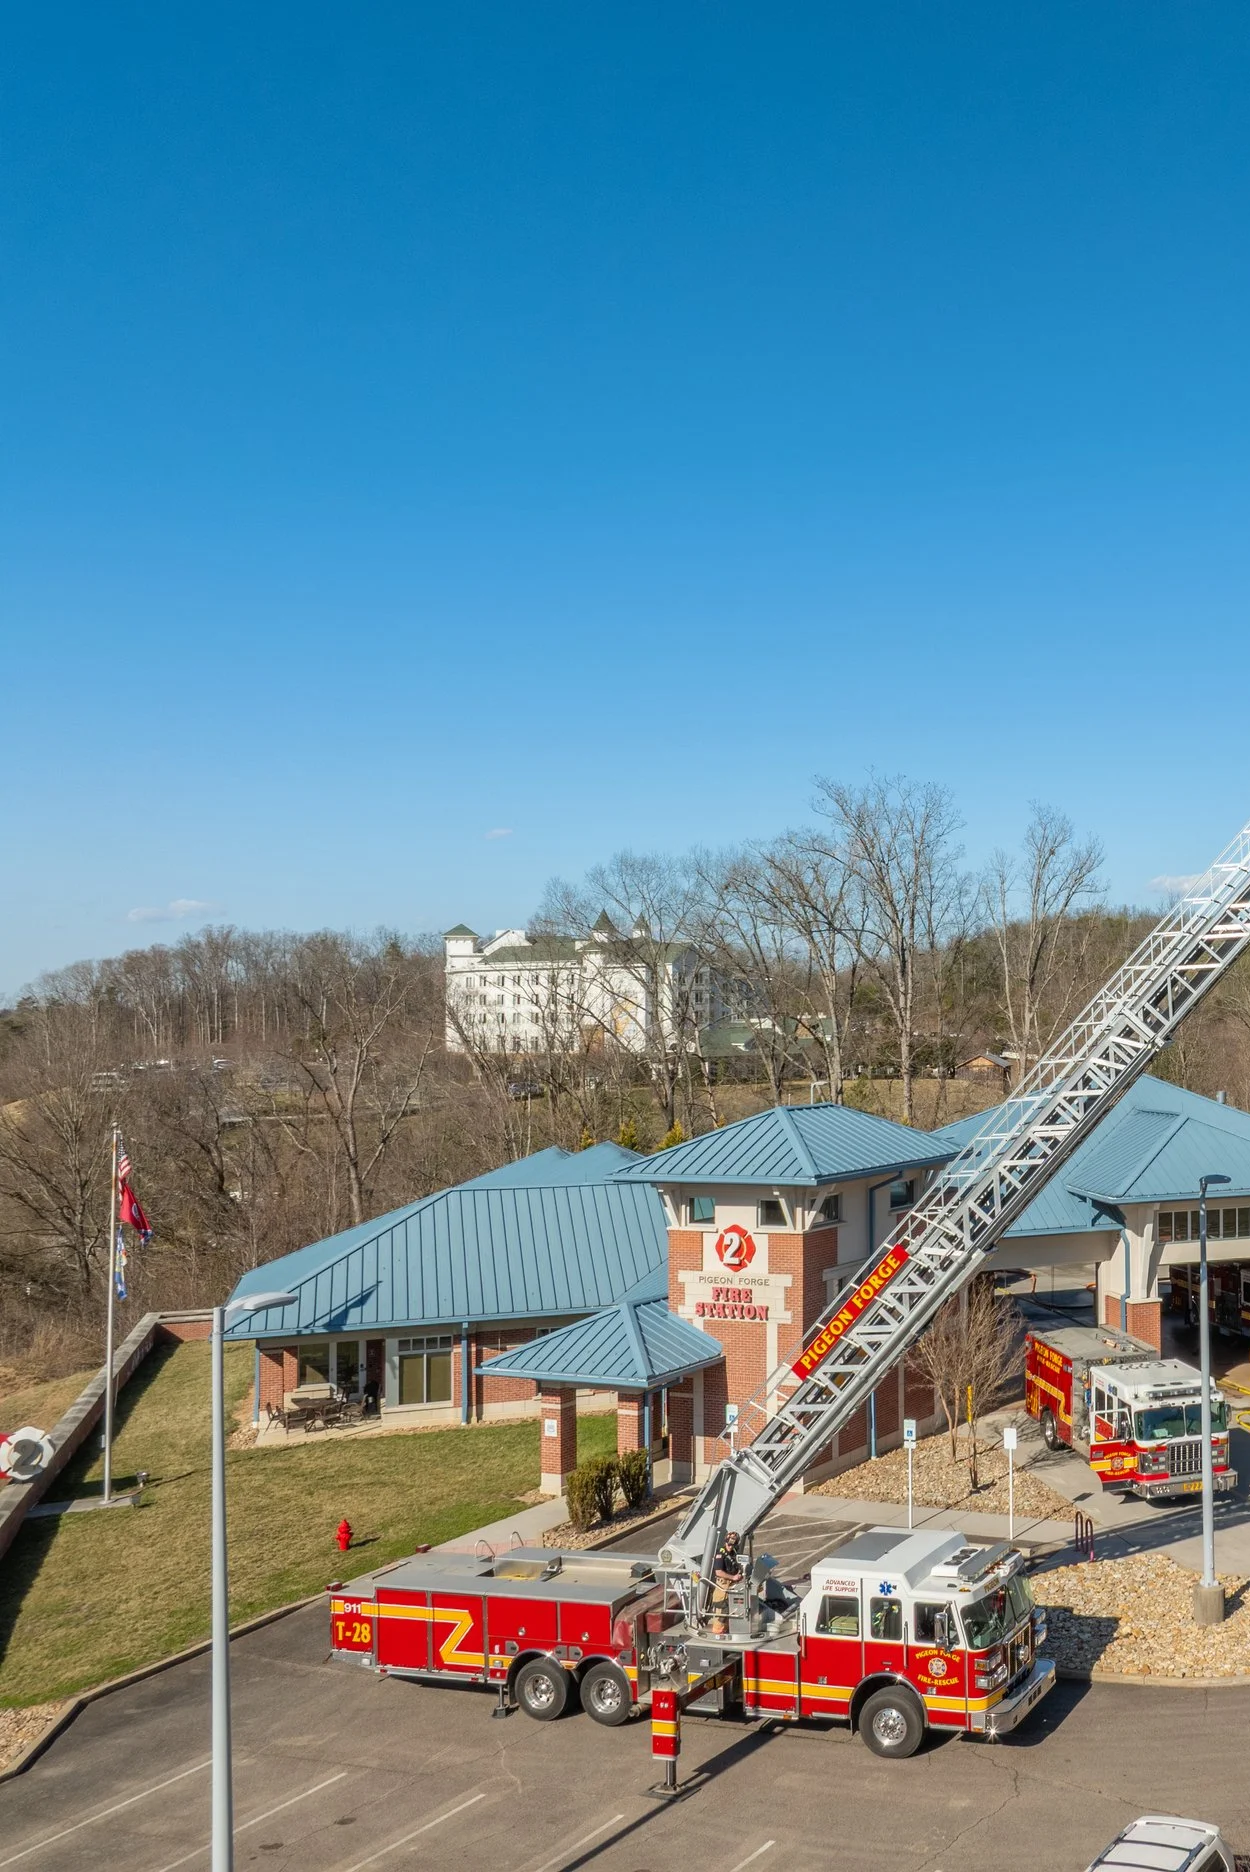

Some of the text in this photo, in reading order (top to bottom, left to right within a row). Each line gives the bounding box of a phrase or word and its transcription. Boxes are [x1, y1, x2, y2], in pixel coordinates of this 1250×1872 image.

[723, 1232, 741, 1265] 2
[698, 1276, 770, 1287] PIGEON FORGE
[712, 1286, 753, 1303] FIRE
[695, 1301, 769, 1321] STATION
[800, 1253, 901, 1371] PIGEON FORGE
[13, 1439, 42, 1475] 2
[825, 1579, 856, 1587] ADVANCED
[344, 1603, 361, 1614] 911
[336, 1621, 371, 1643] T-28
[915, 1649, 938, 1659] PIGEON
